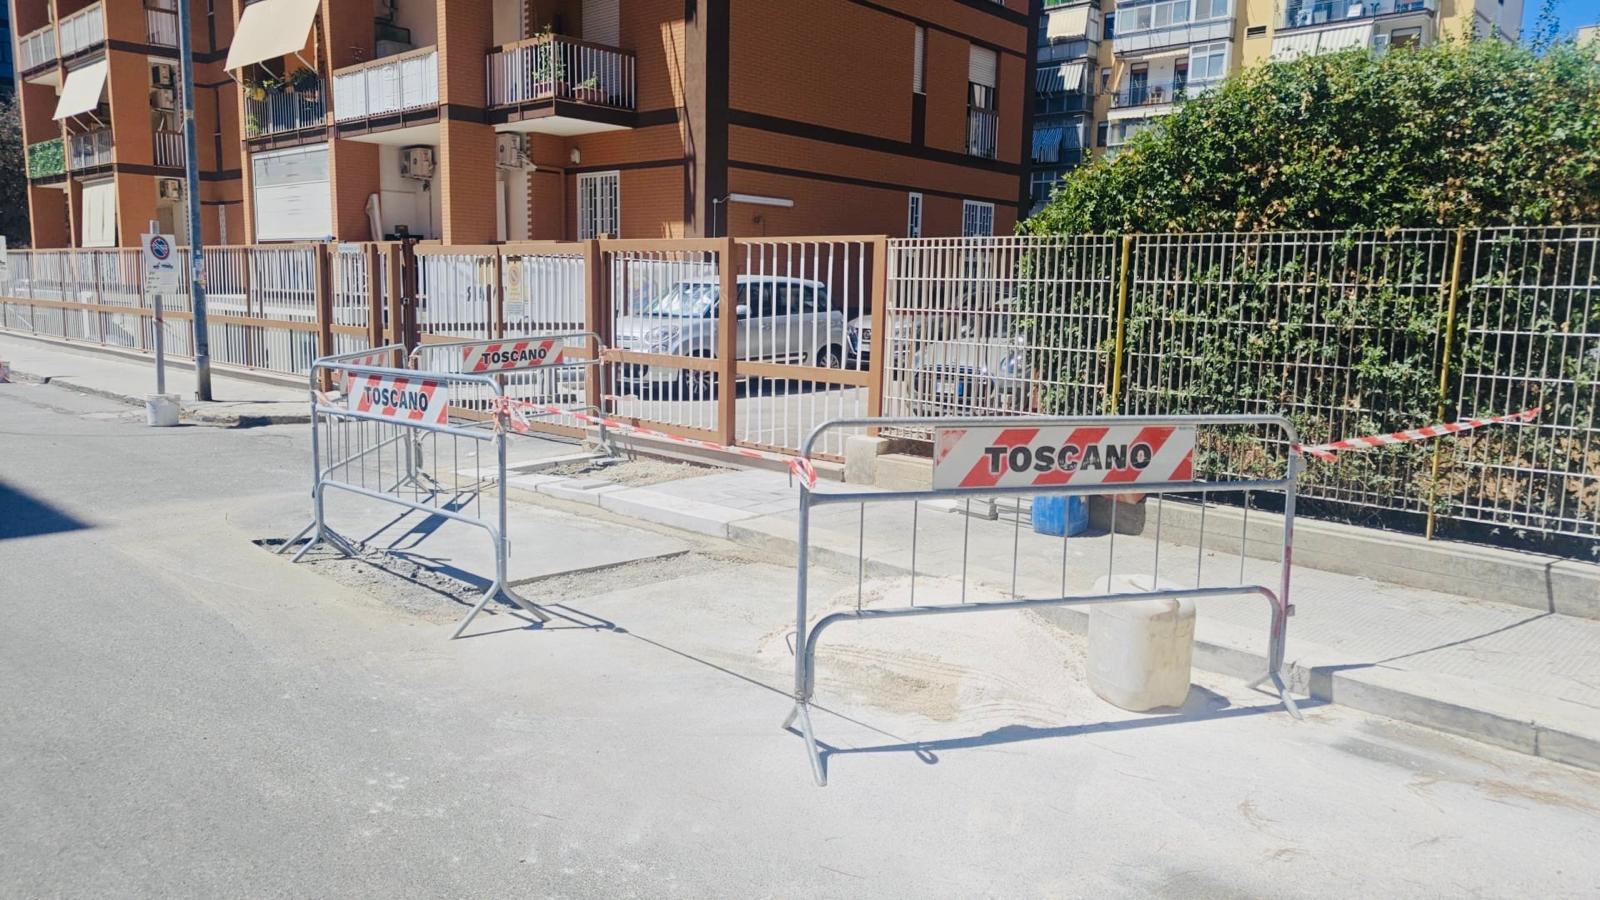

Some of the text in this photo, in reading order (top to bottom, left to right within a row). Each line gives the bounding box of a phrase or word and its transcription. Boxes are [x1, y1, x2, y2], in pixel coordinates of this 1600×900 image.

[481, 348, 547, 364] TOSCANO
[364, 386, 429, 412] TOSCANO
[984, 444, 1152, 472] TOSCANO
